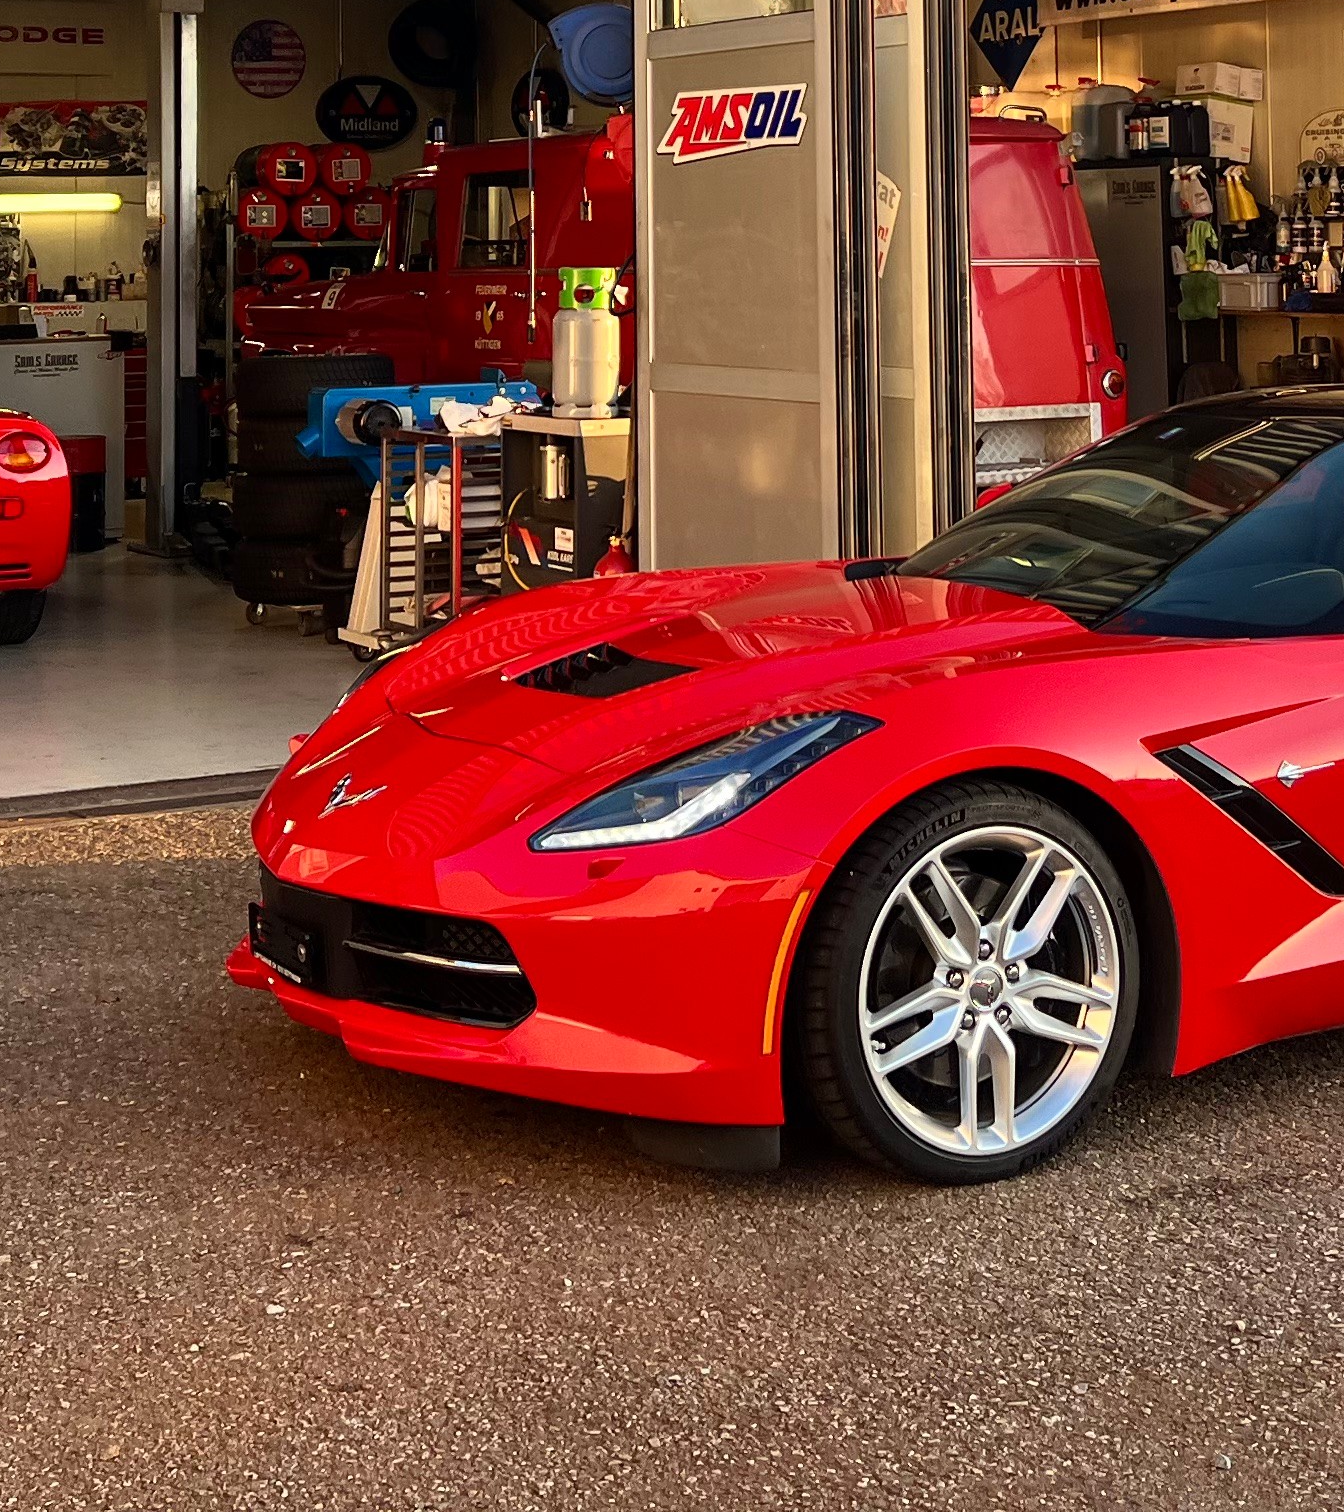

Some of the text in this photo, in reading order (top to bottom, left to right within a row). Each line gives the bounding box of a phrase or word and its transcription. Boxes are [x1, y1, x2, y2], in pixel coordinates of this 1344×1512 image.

[978, 6, 1041, 43] ARAL
[340, 117, 400, 132] Midland
[664, 88, 803, 158] AMSOIL
[0, 156, 111, 173] Systems
[888, 808, 966, 872] MICHELIN
